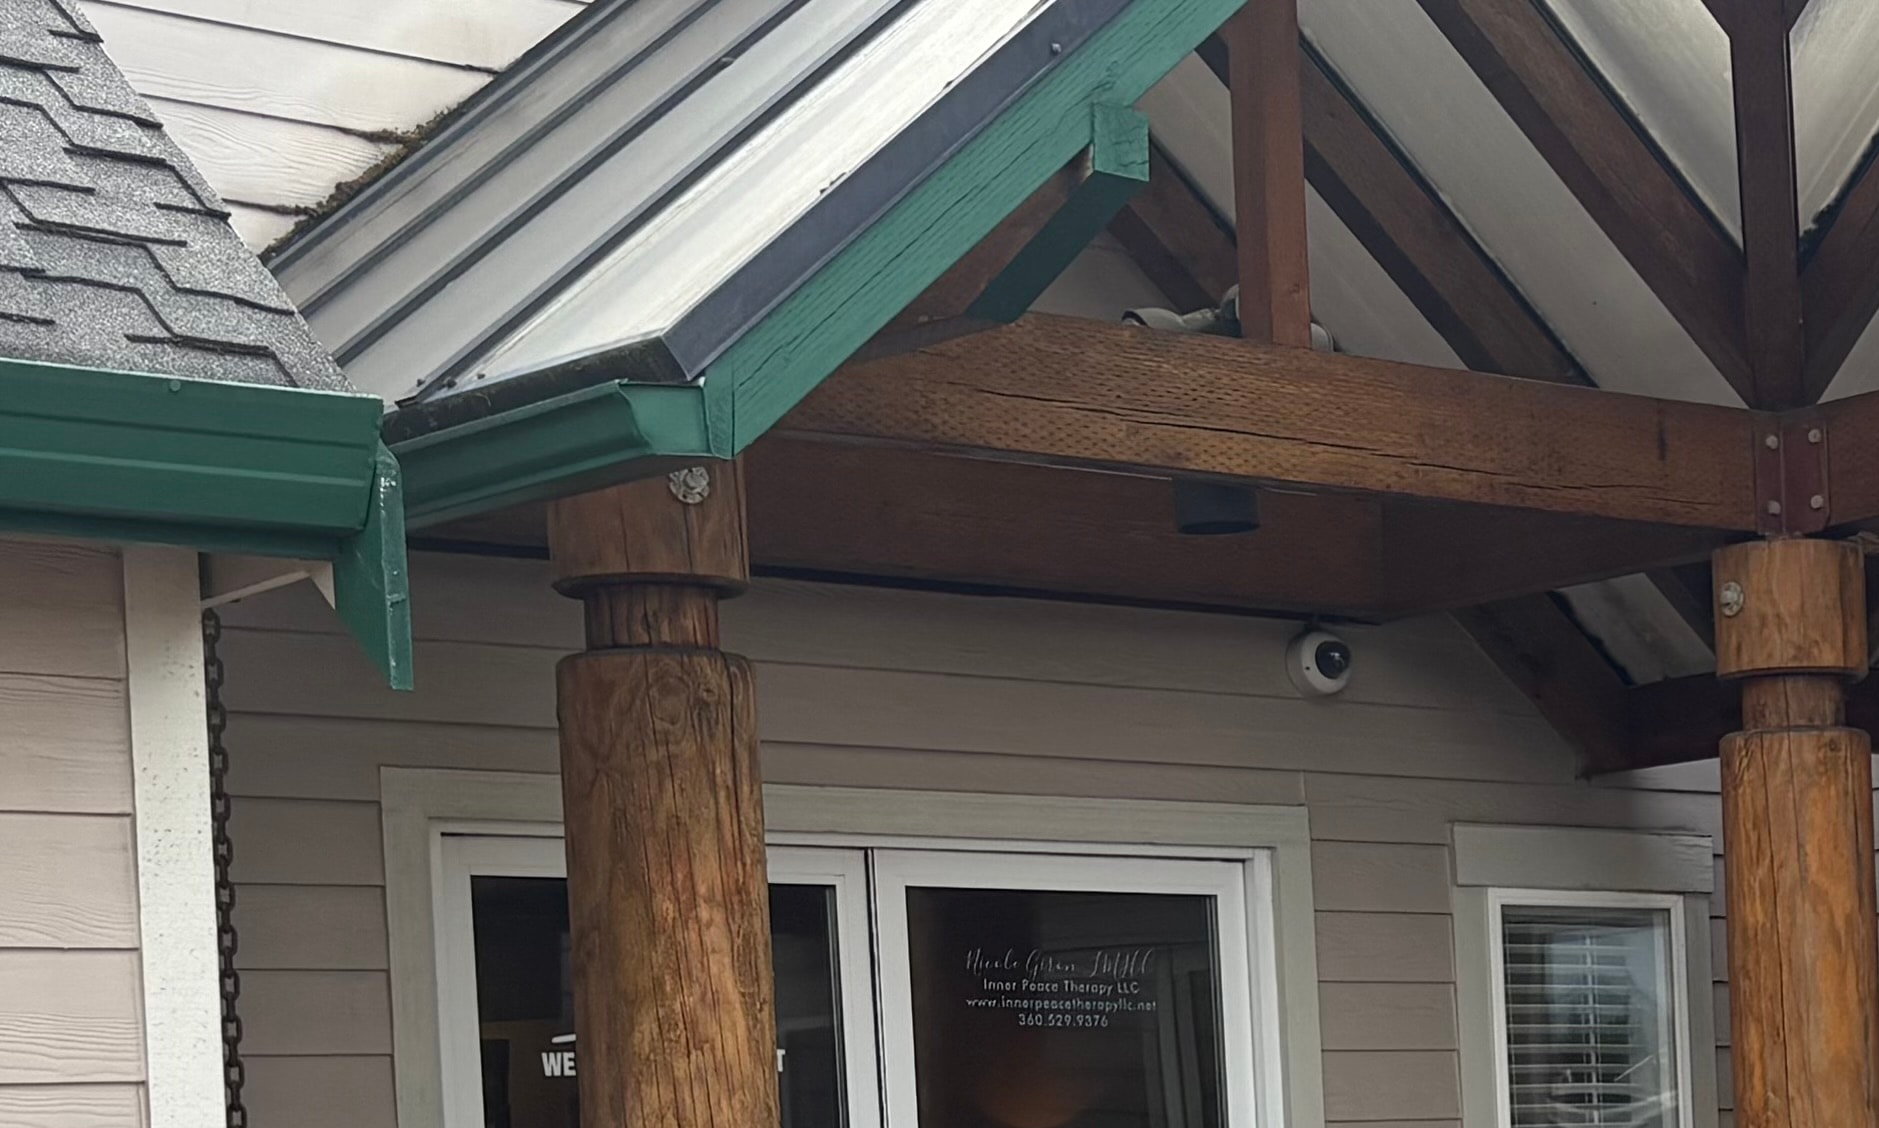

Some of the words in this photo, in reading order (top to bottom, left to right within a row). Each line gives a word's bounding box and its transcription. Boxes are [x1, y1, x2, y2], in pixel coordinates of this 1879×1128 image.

[983, 978, 1017, 991] Inner
[1022, 979, 1059, 992] Peace
[1064, 980, 1113, 996] Therapy
[1118, 982, 1140, 994] LLC
[966, 995, 1156, 1012] www.innerpeacetherapyllc.net
[1018, 1013, 1108, 1027] 360.529.9376
